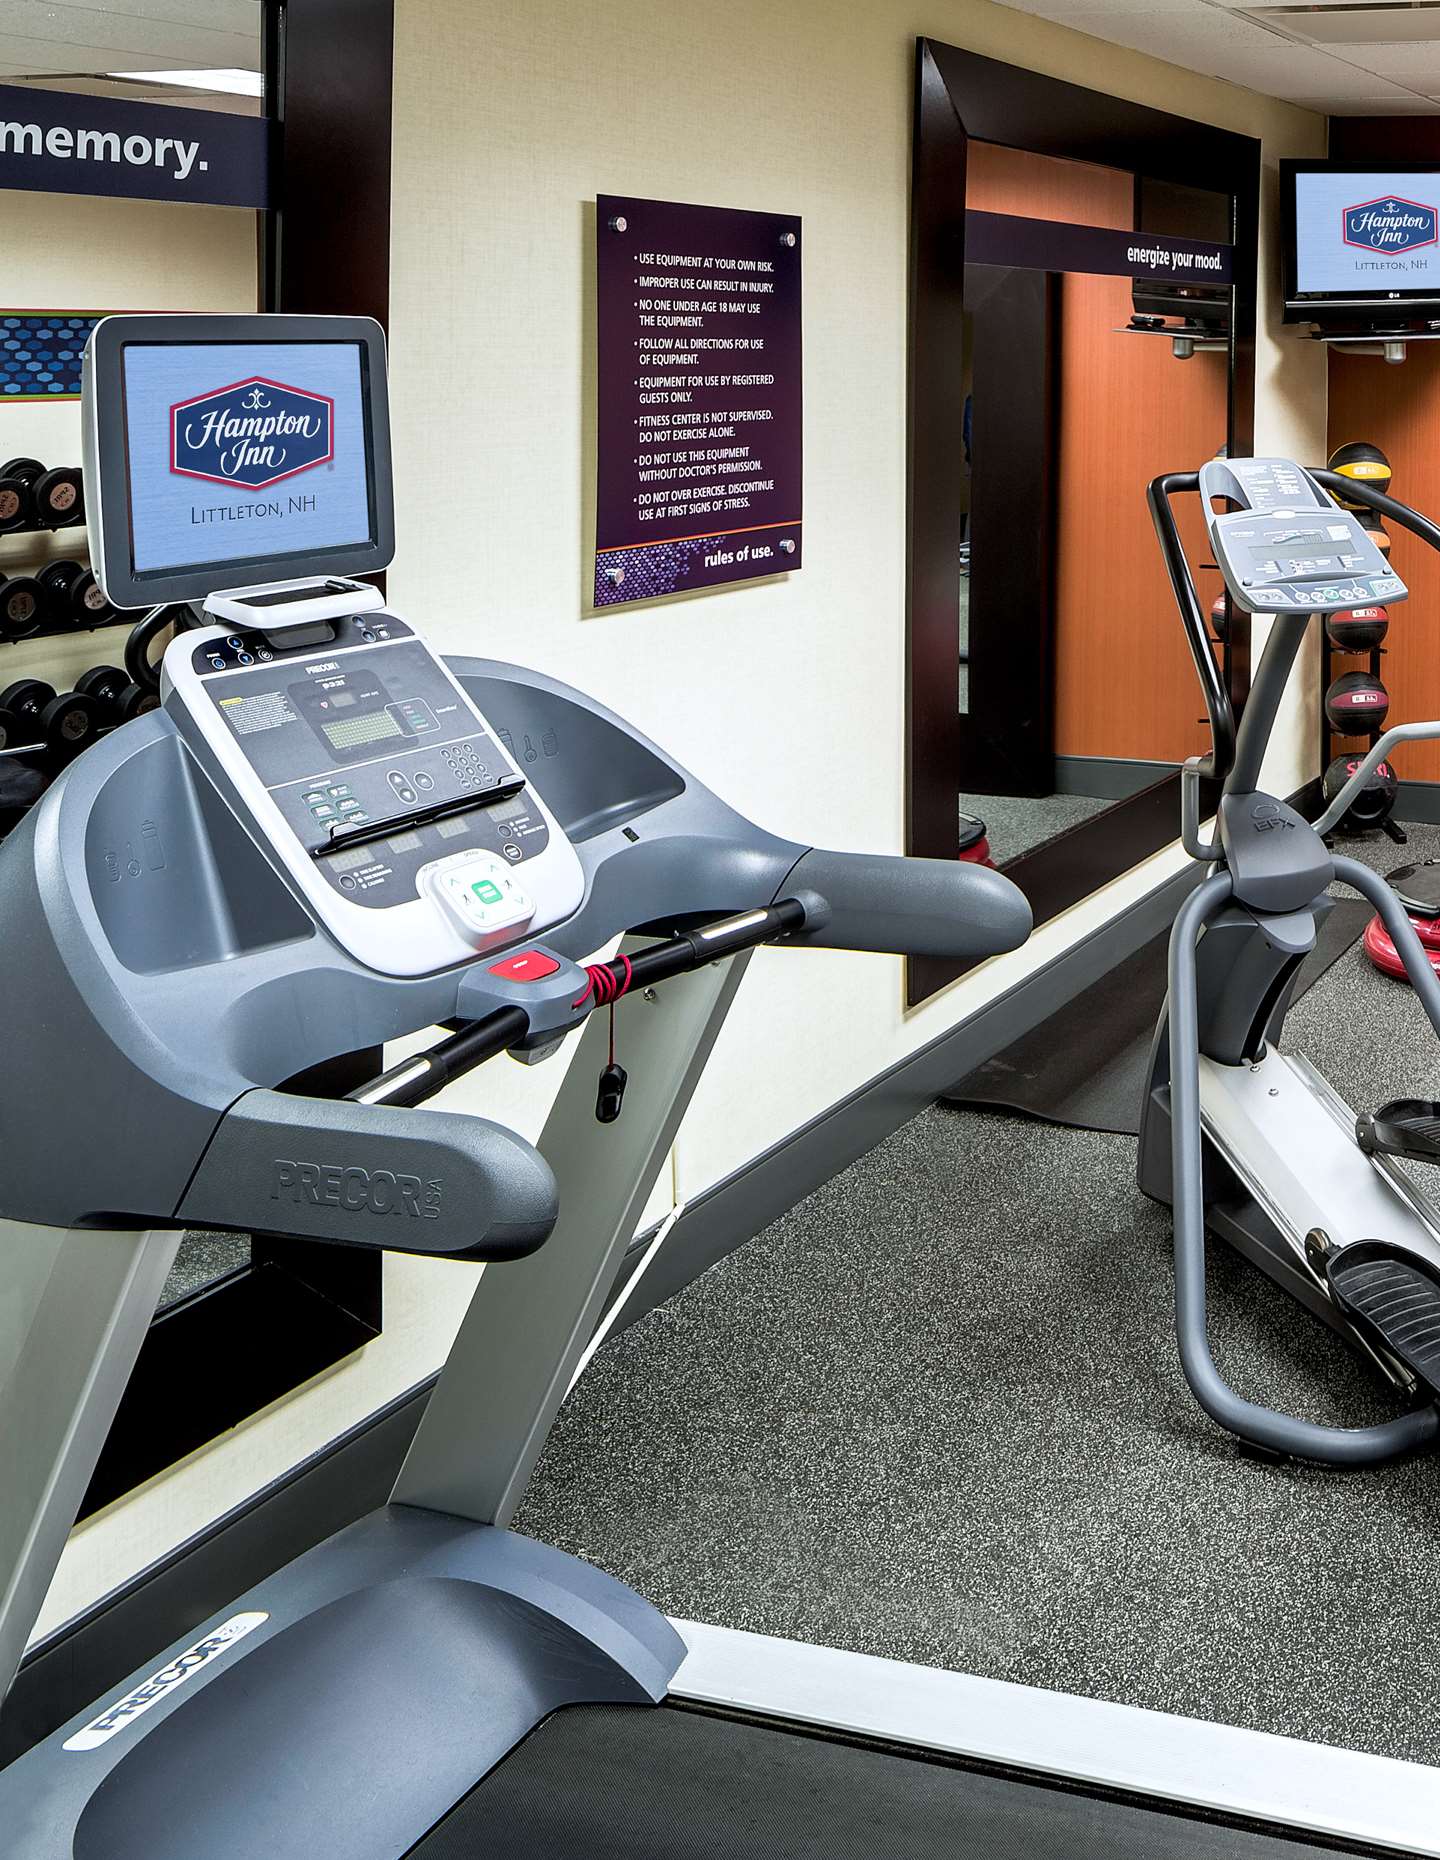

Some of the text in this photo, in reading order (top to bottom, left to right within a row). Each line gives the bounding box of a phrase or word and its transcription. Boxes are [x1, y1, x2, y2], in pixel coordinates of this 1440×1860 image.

[0, 121, 208, 180] memory.
[1351, 212, 1430, 232] Hampton
[1370, 227, 1409, 247] Inn
[639, 253, 774, 272] USE EQUIPMENT AT YOUR OWN RISK.
[1127, 245, 1223, 271] energize your mood.
[1411, 260, 1428, 269] NH
[639, 277, 774, 293] IMPROPER USE CAN RESULT IN INJURY.
[639, 300, 760, 313] NO ONE UNDER AGE 18 MAY USE
[639, 315, 703, 328] THE EQUIPMENT.
[639, 338, 763, 349] FOLLOW ALL DIRECTIONS FOR USE
[639, 354, 699, 366] OF EQUIPMENT.
[639, 375, 774, 389] EQUIPMENT FOR USE BY REGISTERED
[639, 392, 692, 404] GUESTS ONLY.
[639, 410, 773, 427] FITNESS CENTER IS NOT SUPERVISED.
[185, 409, 321, 449] Hampton
[639, 427, 736, 442] DO NOT EXERCISE ALONE.
[220, 439, 286, 475] Inn
[639, 447, 749, 466] DO NOT USE THIS EQUIPMENT
[639, 461, 762, 481] WITHOUT DOCTOR'S PERMISSION.
[639, 480, 774, 505] DO NOT OVER EXERCISE. DISCONTINUE
[288, 494, 316, 514] NH
[639, 498, 750, 520] USE AT FIRST SIGNS OF STRESS.
[704, 546, 773, 567] rules of use.
[271, 1159, 421, 1217] PRECOR
[423, 1178, 443, 1219] USA
[88, 1637, 232, 1731] PRECOR
